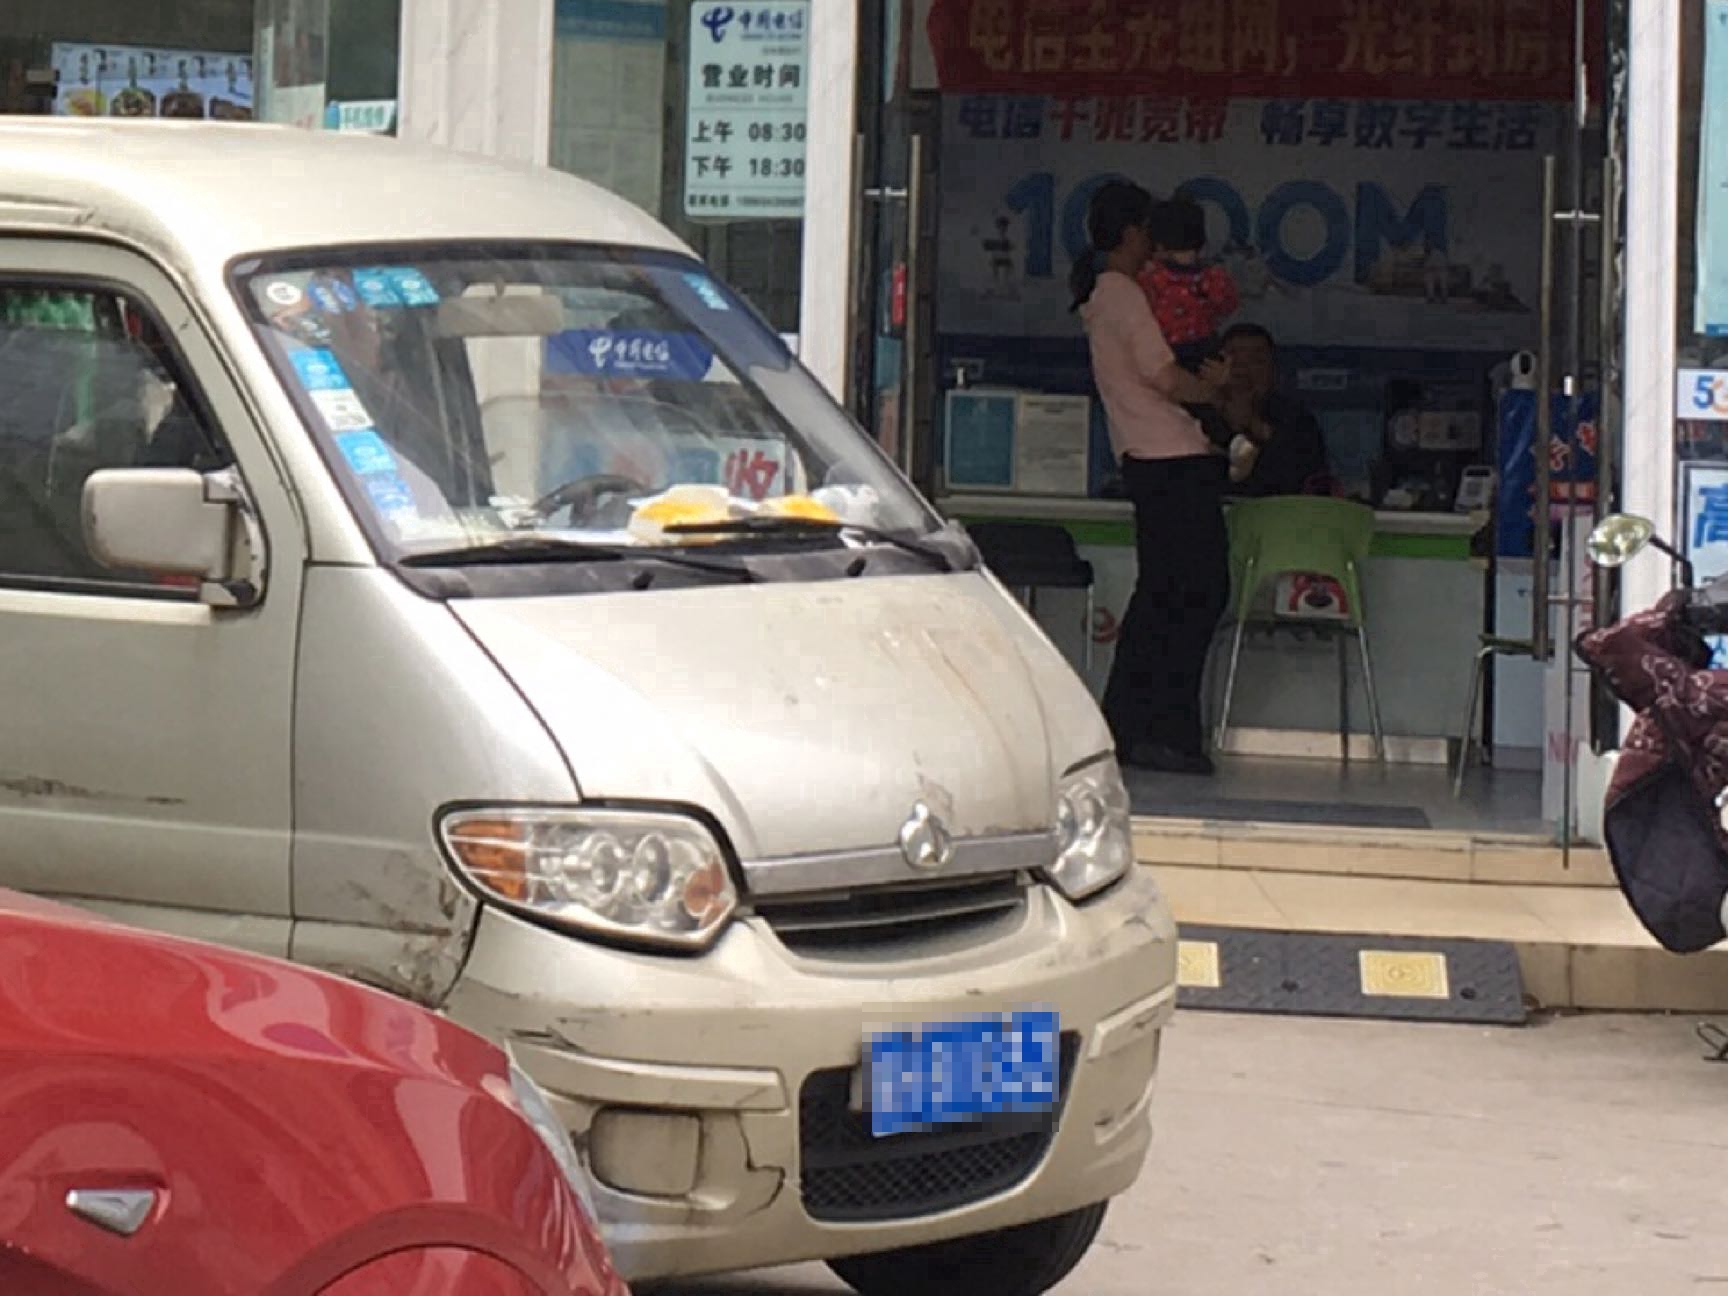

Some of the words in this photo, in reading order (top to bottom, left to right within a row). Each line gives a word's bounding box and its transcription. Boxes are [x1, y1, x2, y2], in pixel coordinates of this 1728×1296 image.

[702, 64, 801, 88] 营业时间
[691, 119, 734, 143] 上午
[748, 122, 808, 143] 08:30
[691, 154, 733, 178] 下午
[749, 158, 806, 178] 18:30
